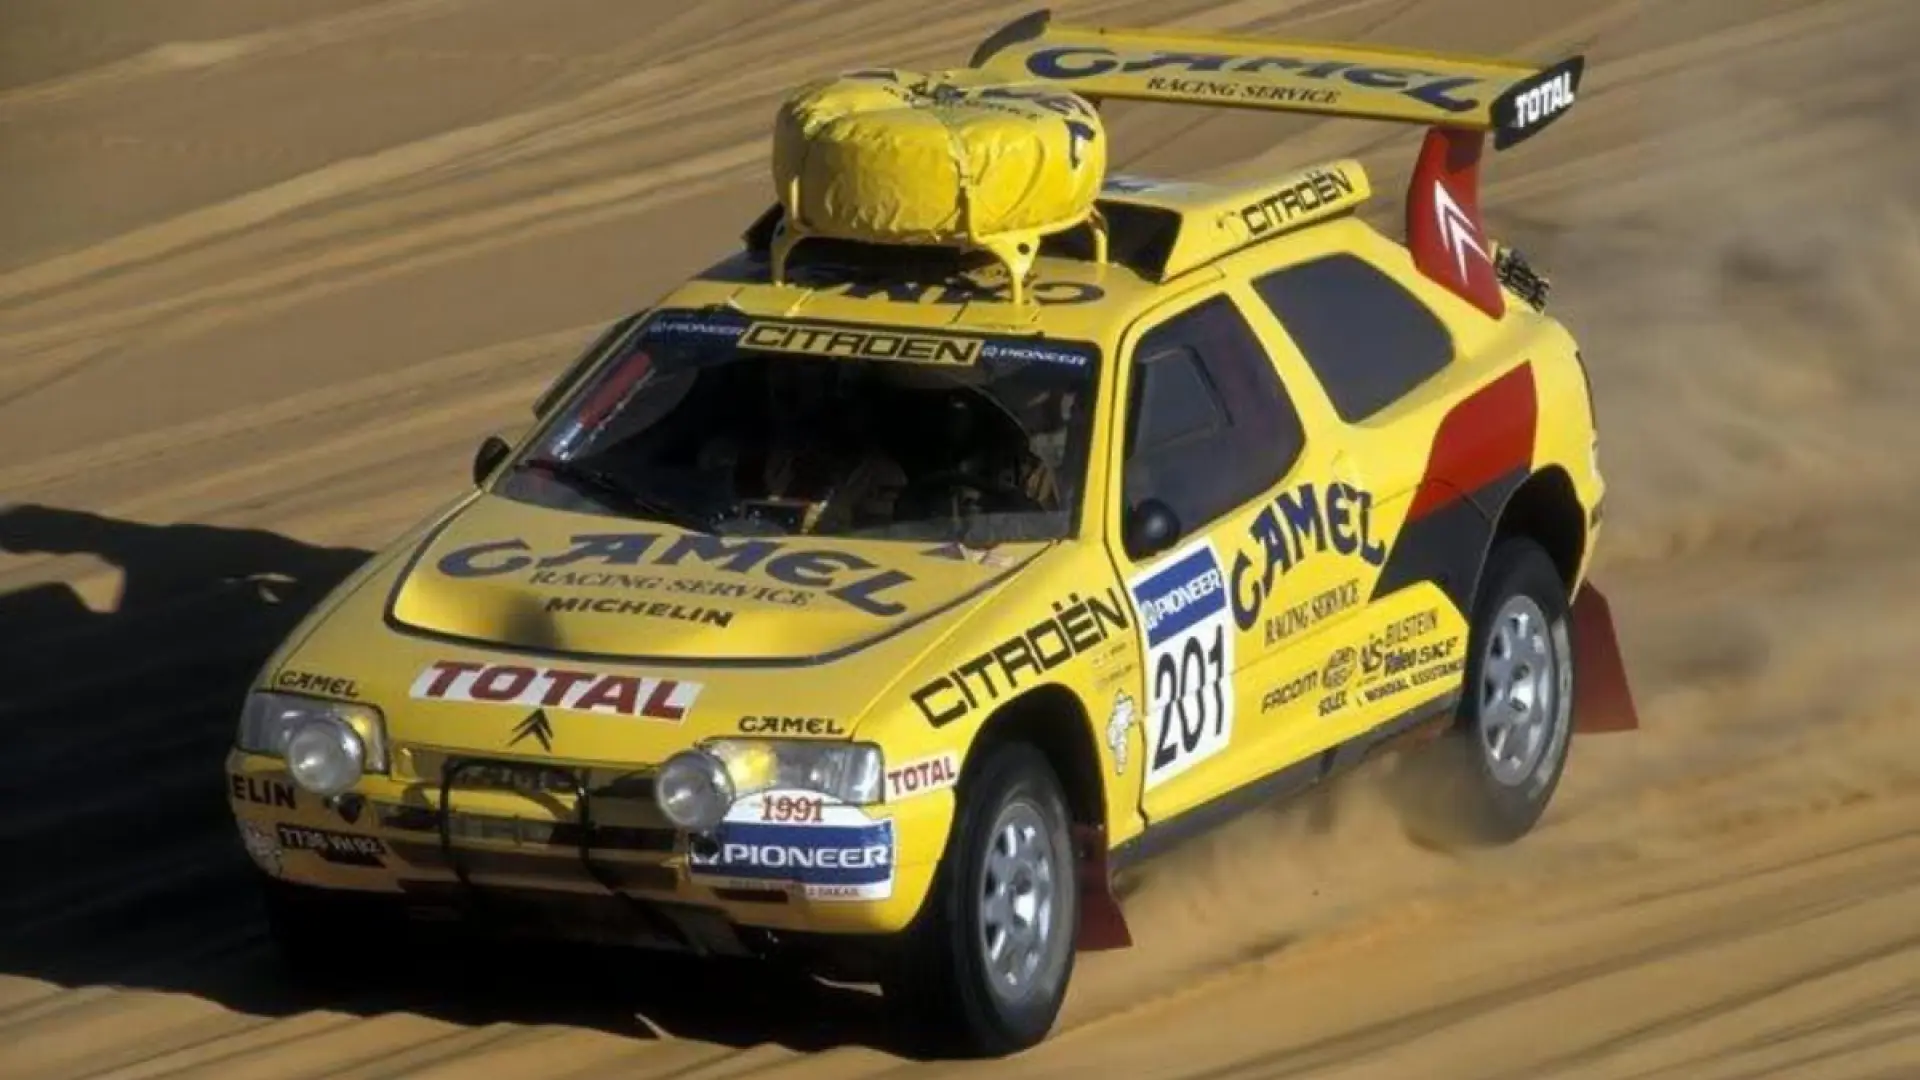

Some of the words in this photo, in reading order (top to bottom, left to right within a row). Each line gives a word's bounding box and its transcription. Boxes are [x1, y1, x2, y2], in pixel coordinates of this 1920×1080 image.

[1026, 47, 1483, 112] CAMEL
[1146, 76, 1237, 97] RACING
[1241, 83, 1339, 104] SERVICE
[1514, 71, 1575, 128] TOTAL
[1241, 169, 1354, 235] CITROËN
[743, 324, 977, 363] CITROEN
[439, 533, 917, 617] CAMEL
[1231, 482, 1385, 632] CAMEL
[530, 569, 662, 590] RACING
[664, 578, 819, 606] SERVICE
[544, 596, 734, 627] MICHELIN
[1153, 568, 1222, 621] PIONEER
[1264, 601, 1308, 647] RACING
[1310, 579, 1360, 628] SERVICE
[280, 670, 359, 698] CAMEL
[910, 588, 1129, 729] CITROËN
[426, 661, 694, 721] TOTAL
[1153, 623, 1224, 770] 201
[738, 716, 845, 735] CAMEL
[888, 756, 956, 794] TOTAL
[762, 795, 825, 822] 1991
[724, 844, 889, 869] PIONEER
